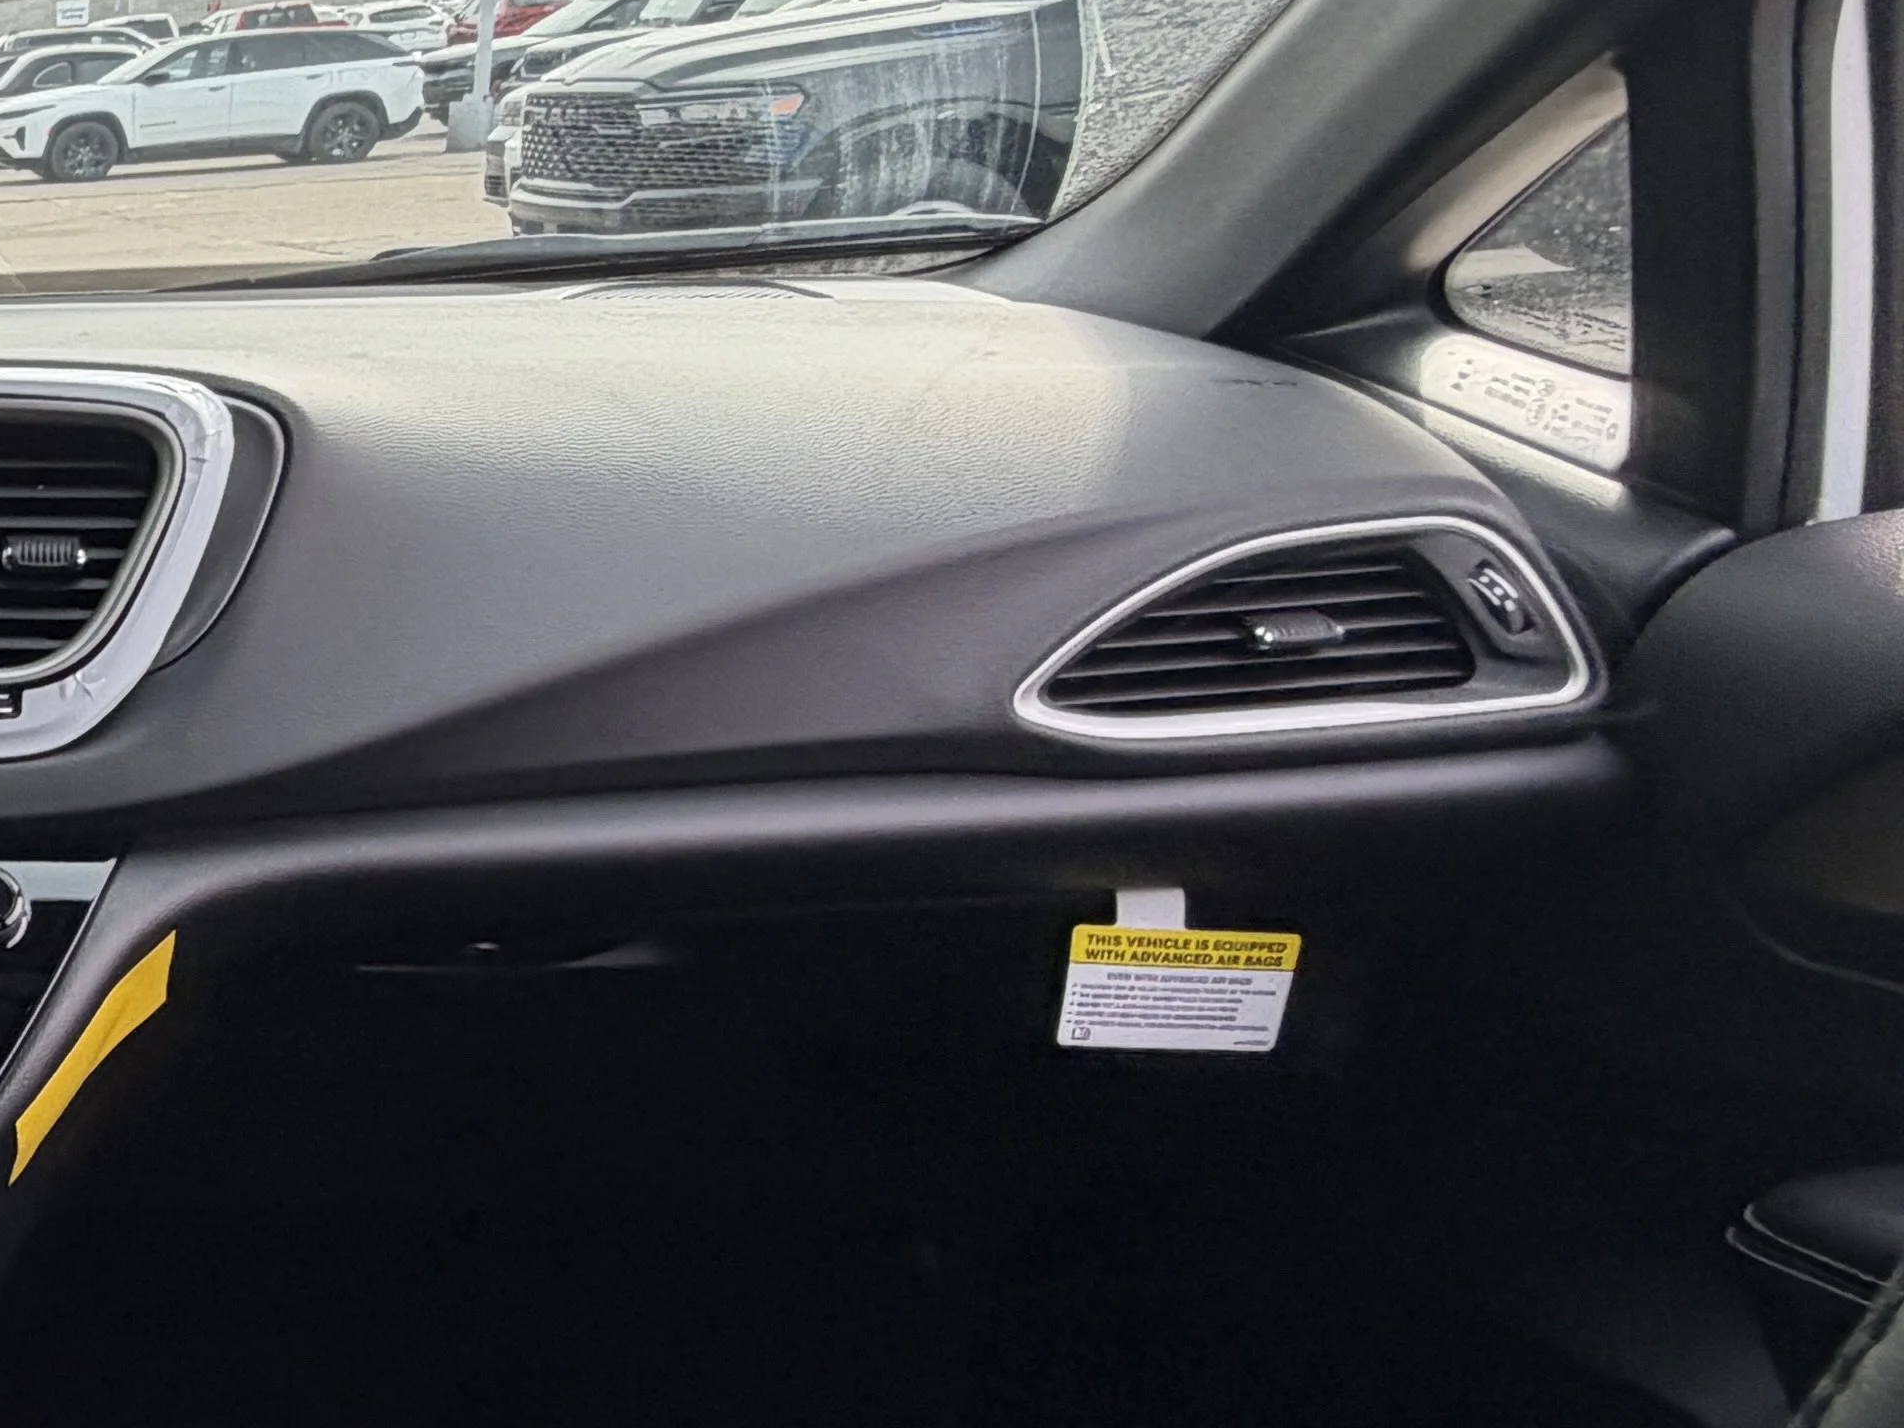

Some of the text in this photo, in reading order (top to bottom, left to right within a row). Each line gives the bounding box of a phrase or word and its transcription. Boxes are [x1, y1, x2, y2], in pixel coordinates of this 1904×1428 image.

[1087, 933, 1288, 954] THIS VEHICLE IS EQUIPPED
[1086, 948, 1284, 967] WITH ADVANCED AIR BAGS
